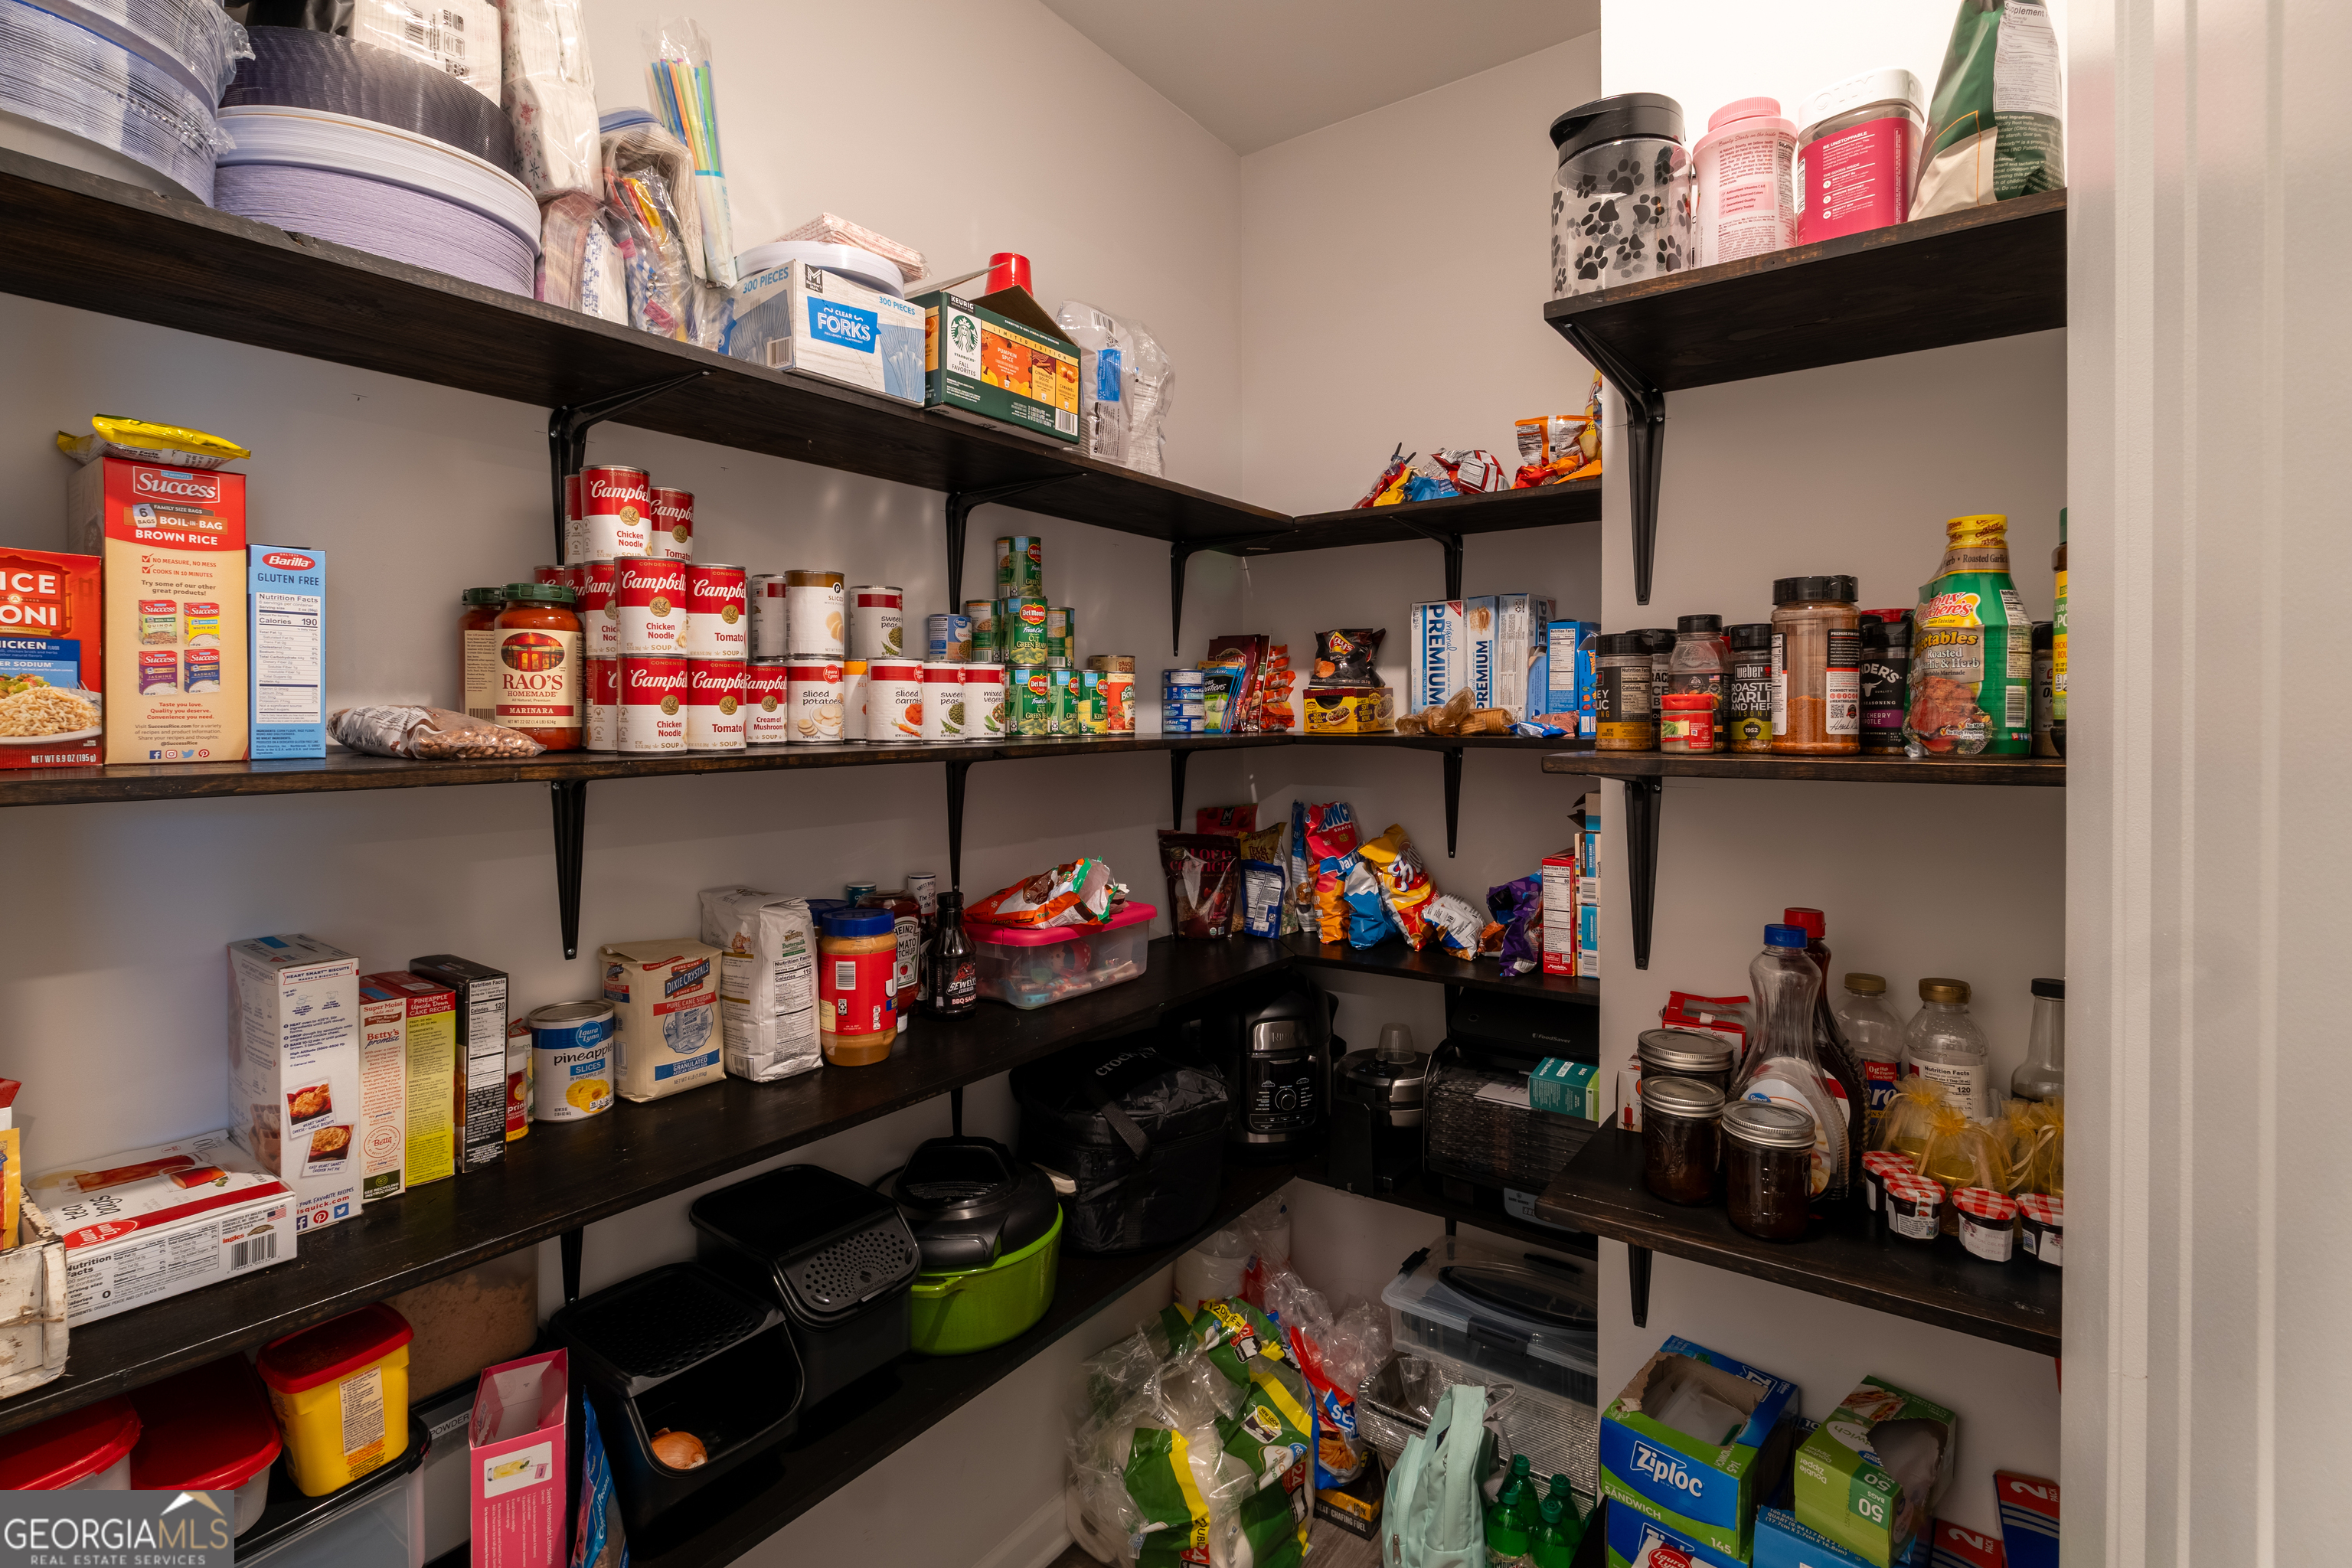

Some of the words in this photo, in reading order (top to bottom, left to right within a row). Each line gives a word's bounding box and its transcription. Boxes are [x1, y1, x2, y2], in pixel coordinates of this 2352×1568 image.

[2005, 2, 2044, 17] Supplement
[1831, 131, 1867, 147] UNSTOPPABLE
[743, 279, 758, 293] 300
[760, 267, 789, 287] PIECES
[951, 296, 974, 310] KEURIG
[835, 310, 853, 319] CLEAR
[818, 312, 871, 341] FORKS
[993, 328, 1027, 345] LIMITED
[1034, 345, 1067, 361] EDITION
[998, 348, 1017, 358] PUMPKIN
[1001, 354, 1013, 363] SPICE
[952, 364, 975, 377] FAVORITES
[1035, 370, 1053, 380] CINNAMON
[1060, 384, 1074, 393] CARAMEL
[137, 473, 216, 498] Success
[139, 508, 148, 517] 6
[136, 530, 185, 542] BROWN
[189, 534, 217, 545] RICE
[665, 549, 690, 560] Tomato
[269, 556, 309, 567] Barilla
[257, 573, 294, 583] GLUTEN
[299, 577, 318, 586] FREE
[1929, 592, 1965, 610] Tony
[646, 622, 675, 631] Chicken
[715, 632, 743, 642] Tomato
[1429, 605, 1445, 704] PREMIUM
[1927, 648, 1962, 658] Roasted
[1952, 659, 1980, 668] Herb
[1476, 640, 1488, 708] PREMIUM
[1737, 665, 1762, 678] weber
[502, 674, 563, 690] RAO'S
[31, 755, 43, 763] NET
[894, 926, 913, 935] HEINZ
[667, 978, 683, 993] DIXIE
[684, 962, 709, 983] CRYSTALS
[414, 995, 448, 1004] PINEAPPLE
[367, 1029, 399, 1040] Betty's
[579, 1027, 598, 1038] Laura
[583, 1034, 599, 1043] Lynn
[1538, 1034, 1570, 1044] FoodSaver
[365, 1036, 399, 1049] promise
[554, 1043, 612, 1066] pineapple
[576, 1062, 601, 1073] SLICES
[674, 1057, 707, 1071] GRANULATED
[1869, 1066, 1880, 1074] 0g
[1925, 1066, 1951, 1074] Nutrition
[365, 1187, 398, 1198] INSTRUCTIONS
[374, 1183, 399, 1192] RECYCLING
[313, 1192, 336, 1203] FAVORITE
[338, 1187, 354, 1196] RECIPES
[90, 1195, 122, 1217] bags
[297, 1196, 349, 1214] isquick.com
[62, 1204, 88, 1220] tea
[430, 1413, 469, 1436] POWDER
[1637, 1446, 1703, 1497] Ziploc
[1800, 1458, 1824, 1475] Zipper
[1799, 1465, 1827, 1484] Double
[2011, 1481, 2048, 1500] 2
[2048, 1488, 2059, 1503] PACK
[1867, 1491, 1885, 1504] BAGS
[1858, 1498, 1883, 1523] 50
[1331, 1510, 1351, 1525] CHAFING
[1354, 1519, 1367, 1531] FUEL
[1711, 1537, 1732, 1554] 145
